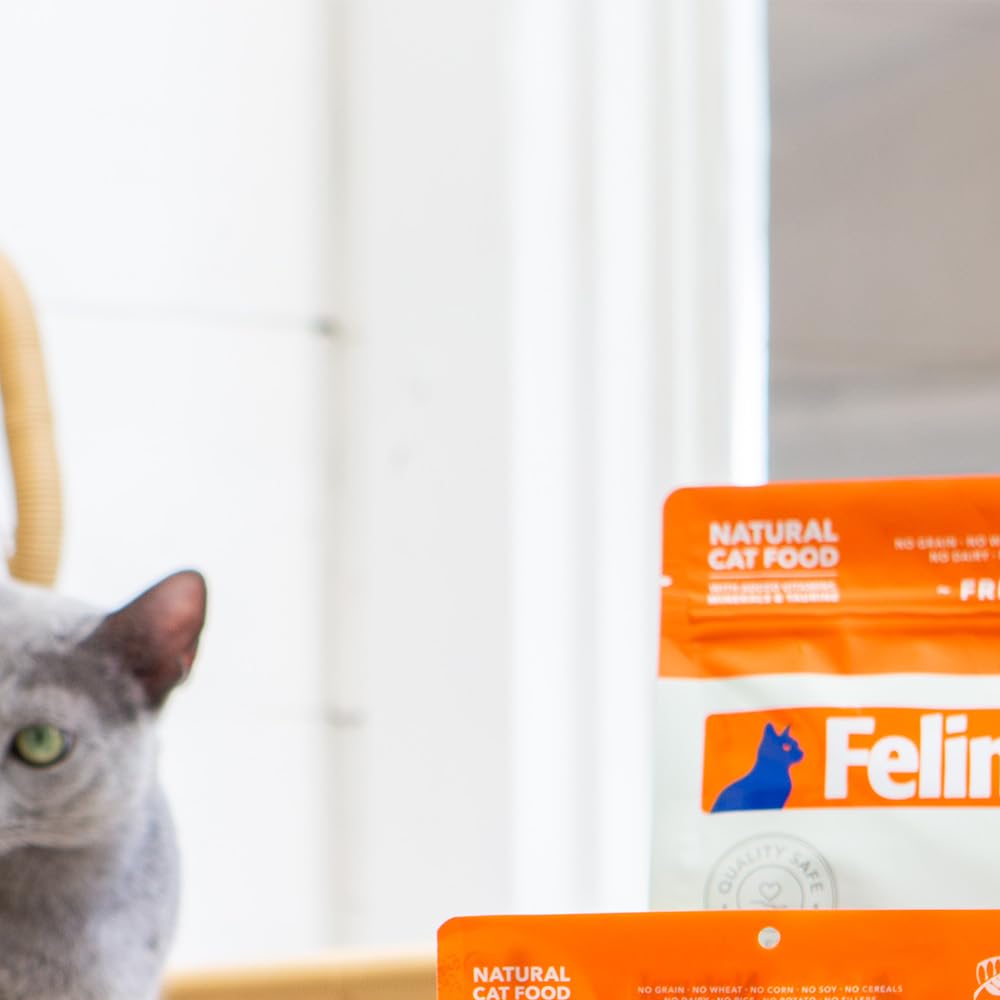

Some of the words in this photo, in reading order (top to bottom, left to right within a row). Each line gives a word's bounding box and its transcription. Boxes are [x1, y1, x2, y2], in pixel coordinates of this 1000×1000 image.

[710, 518, 839, 546] NATURAL
[708, 547, 759, 570] CAT
[763, 546, 840, 569] FOOD
[718, 843, 786, 895] QUALITY
[790, 850, 824, 895] SAFE
[473, 966, 571, 982] NATURAL
[473, 986, 509, 1000] CAT
[515, 986, 571, 1000] FOOD
